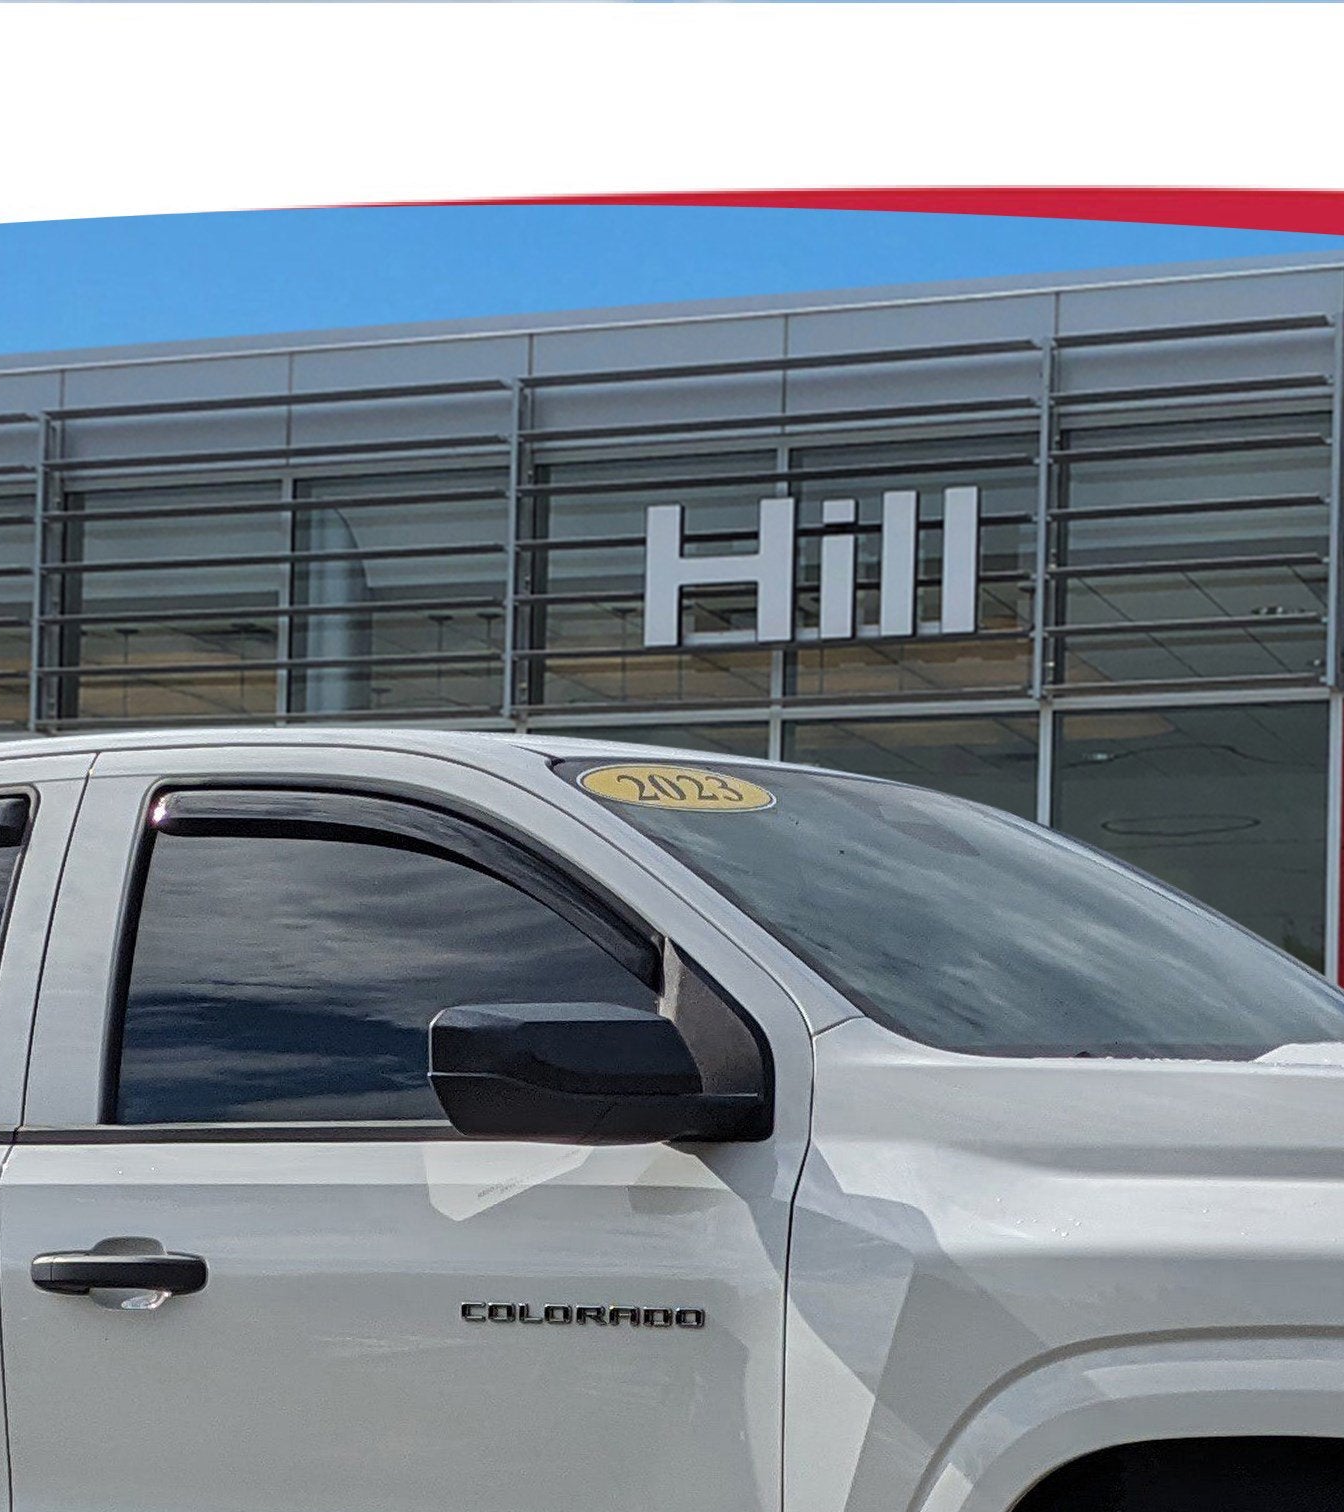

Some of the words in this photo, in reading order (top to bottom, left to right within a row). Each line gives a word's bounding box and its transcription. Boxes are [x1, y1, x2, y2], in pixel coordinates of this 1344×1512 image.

[643, 485, 980, 648] Hill
[616, 773, 744, 802] 2023
[460, 1301, 706, 1328] COLORADO
